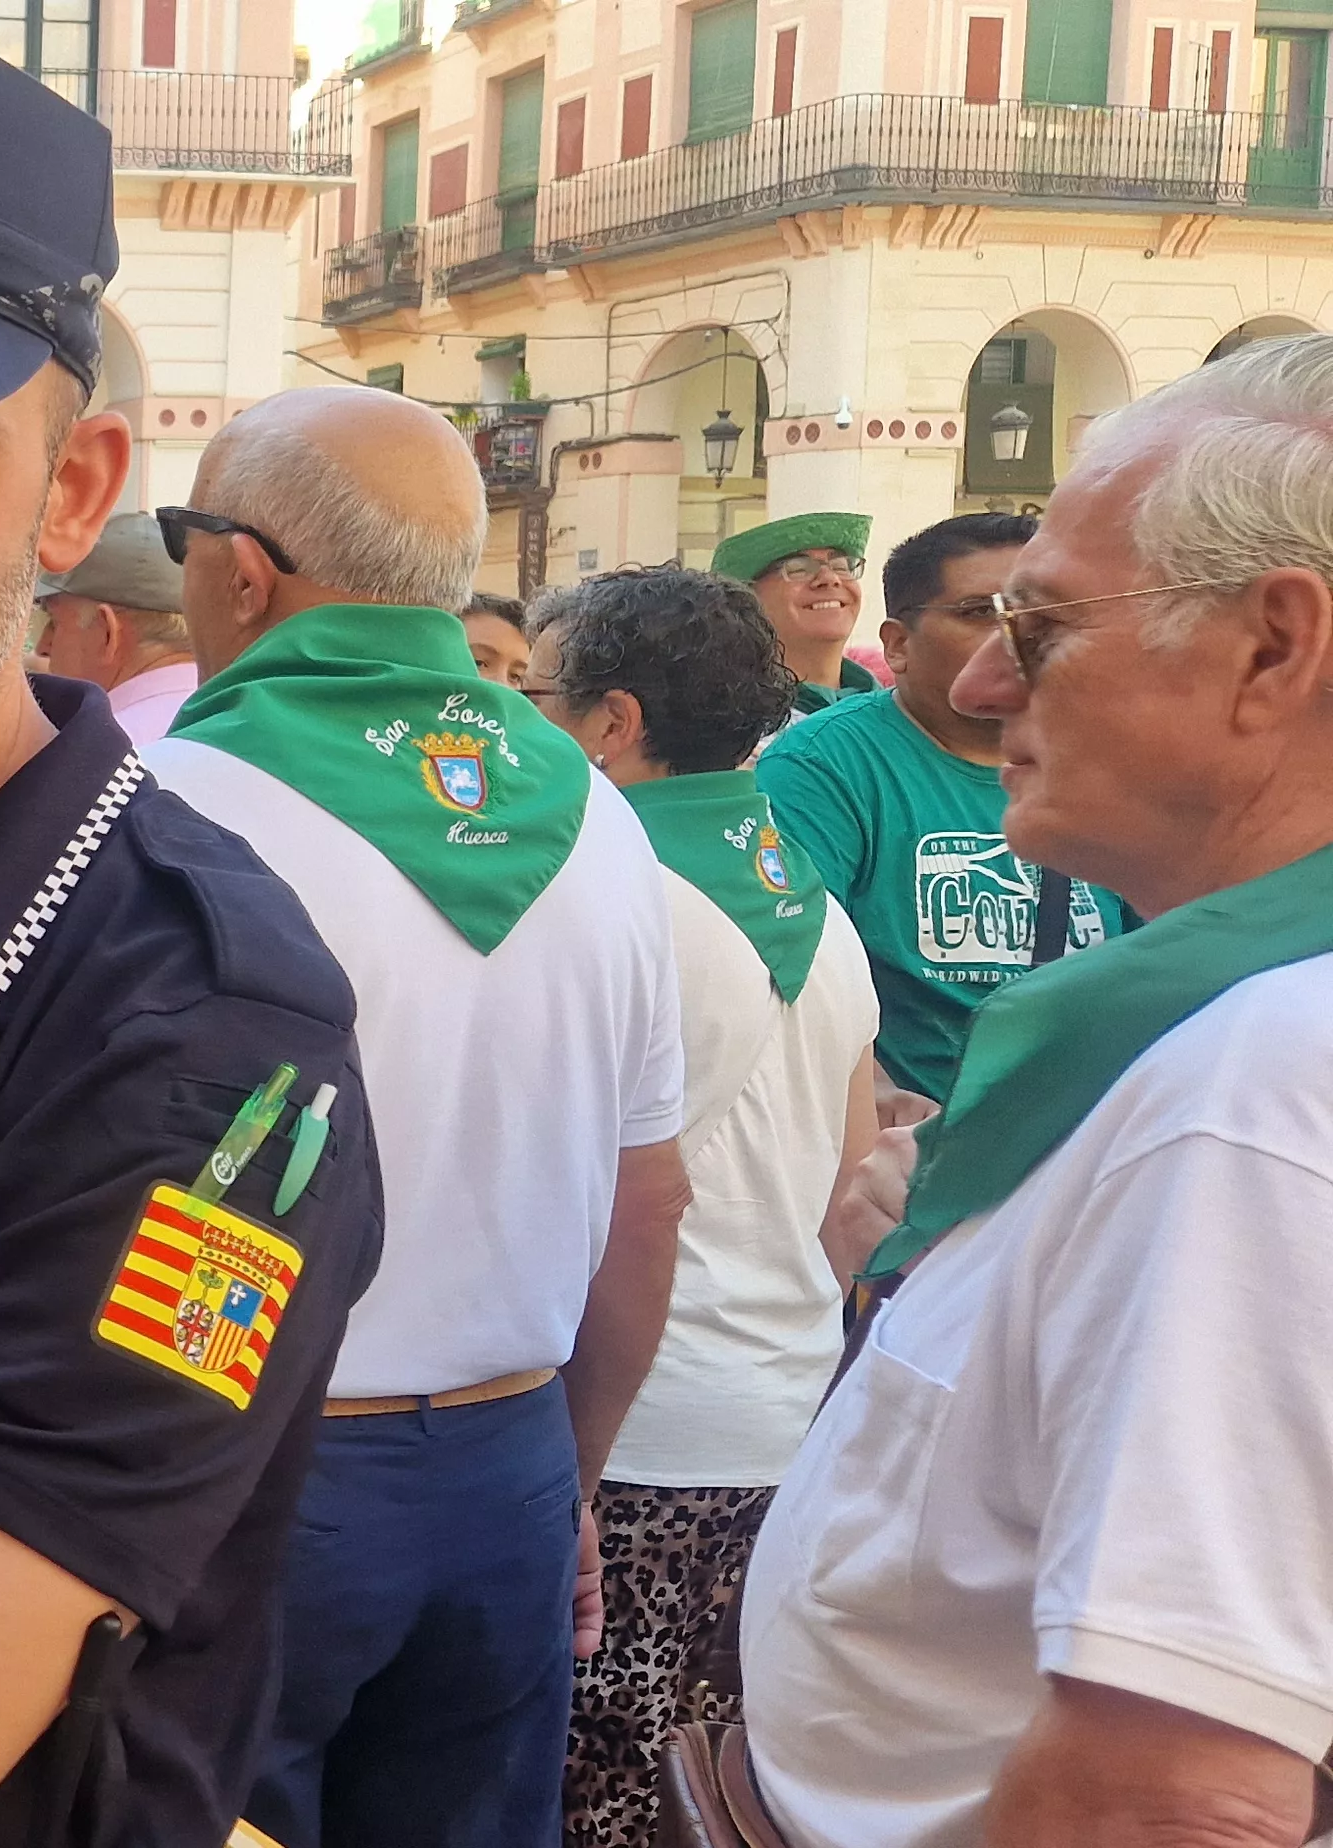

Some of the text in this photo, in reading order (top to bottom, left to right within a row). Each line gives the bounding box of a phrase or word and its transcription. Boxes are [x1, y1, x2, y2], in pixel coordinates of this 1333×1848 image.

[365, 719, 410, 757] San
[446, 820, 509, 845] Huesca
[724, 817, 757, 851] San
[931, 840, 977, 852] ON THE
